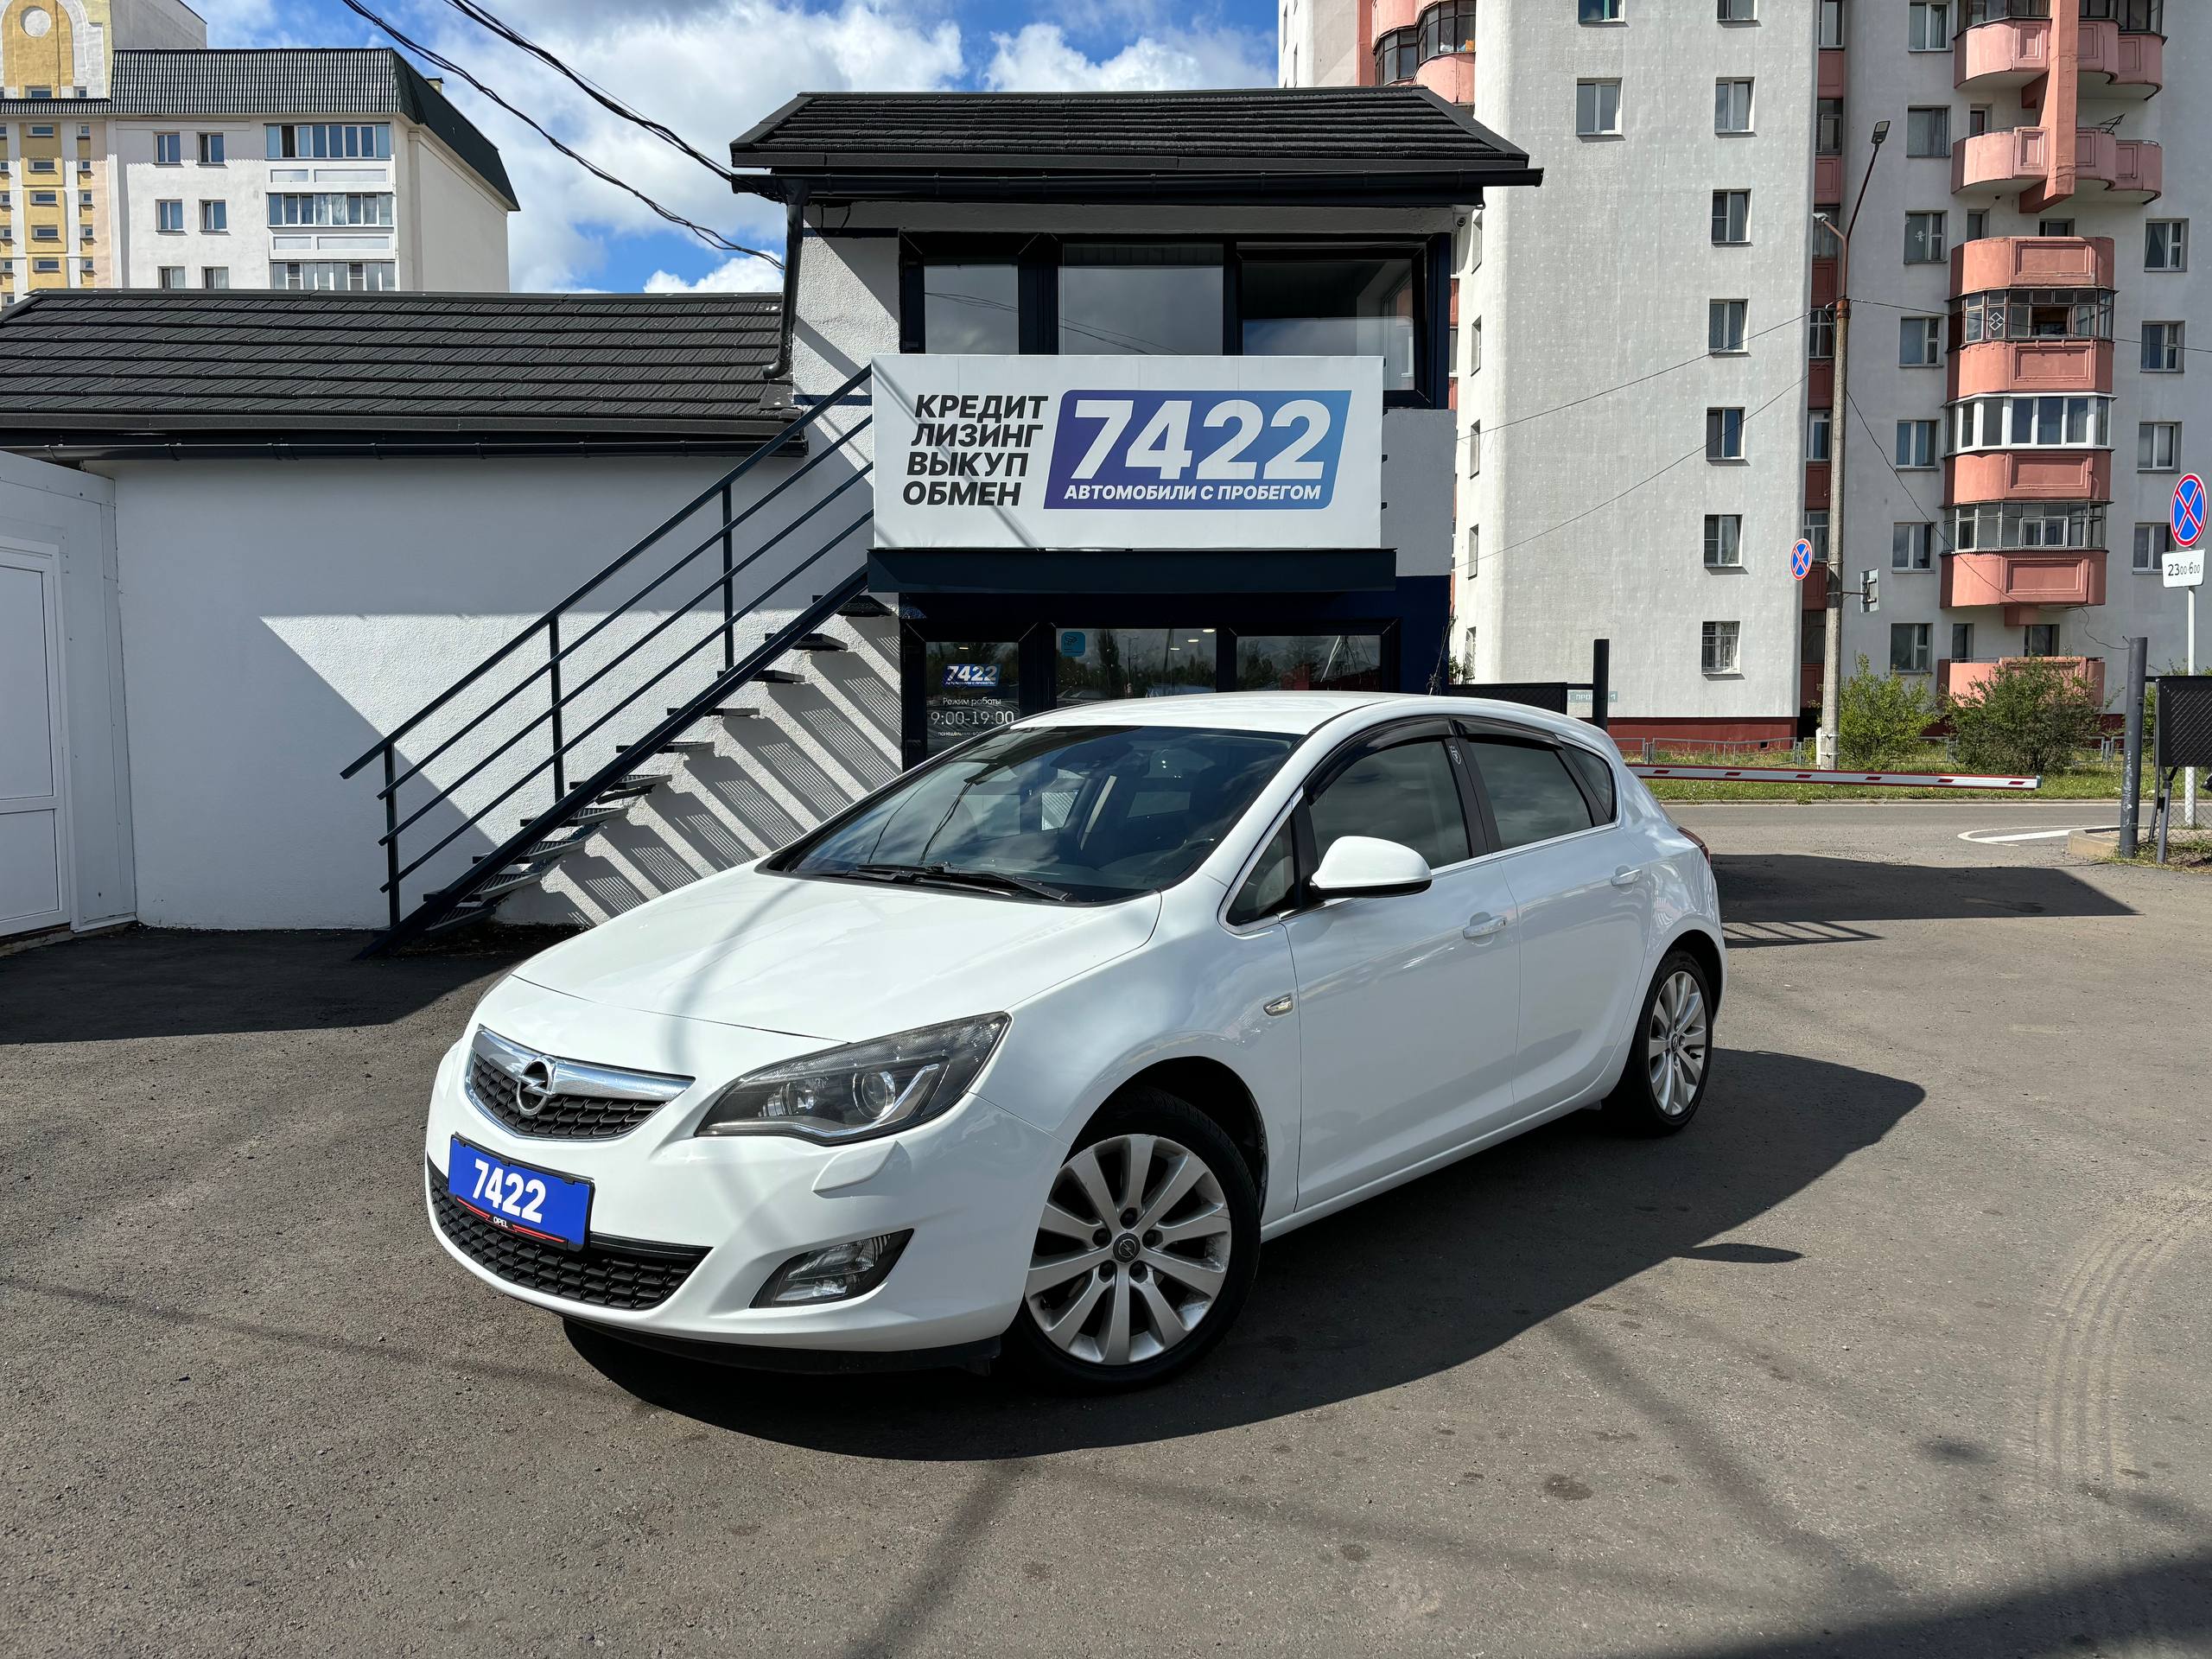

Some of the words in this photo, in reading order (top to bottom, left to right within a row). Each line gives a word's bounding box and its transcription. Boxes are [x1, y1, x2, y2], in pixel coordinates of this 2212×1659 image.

[915, 394, 1049, 423] КРЕДИТ
[911, 423, 1044, 448] ЛИЗИНГ
[1071, 399, 1331, 480] 7422
[906, 452, 1029, 477] ВЫКУП
[902, 480, 1021, 505] ОБМЕН
[1064, 485, 1198, 500] АВТОМОБИЛИ
[1200, 485, 1214, 500] С
[1217, 485, 1322, 500] ПРОБЕГОМ
[947, 665, 997, 682] 7422
[943, 696, 969, 705] Режим
[971, 696, 1001, 707] работы
[472, 1158, 546, 1224] 7422
[493, 1216, 509, 1229] OPEL
